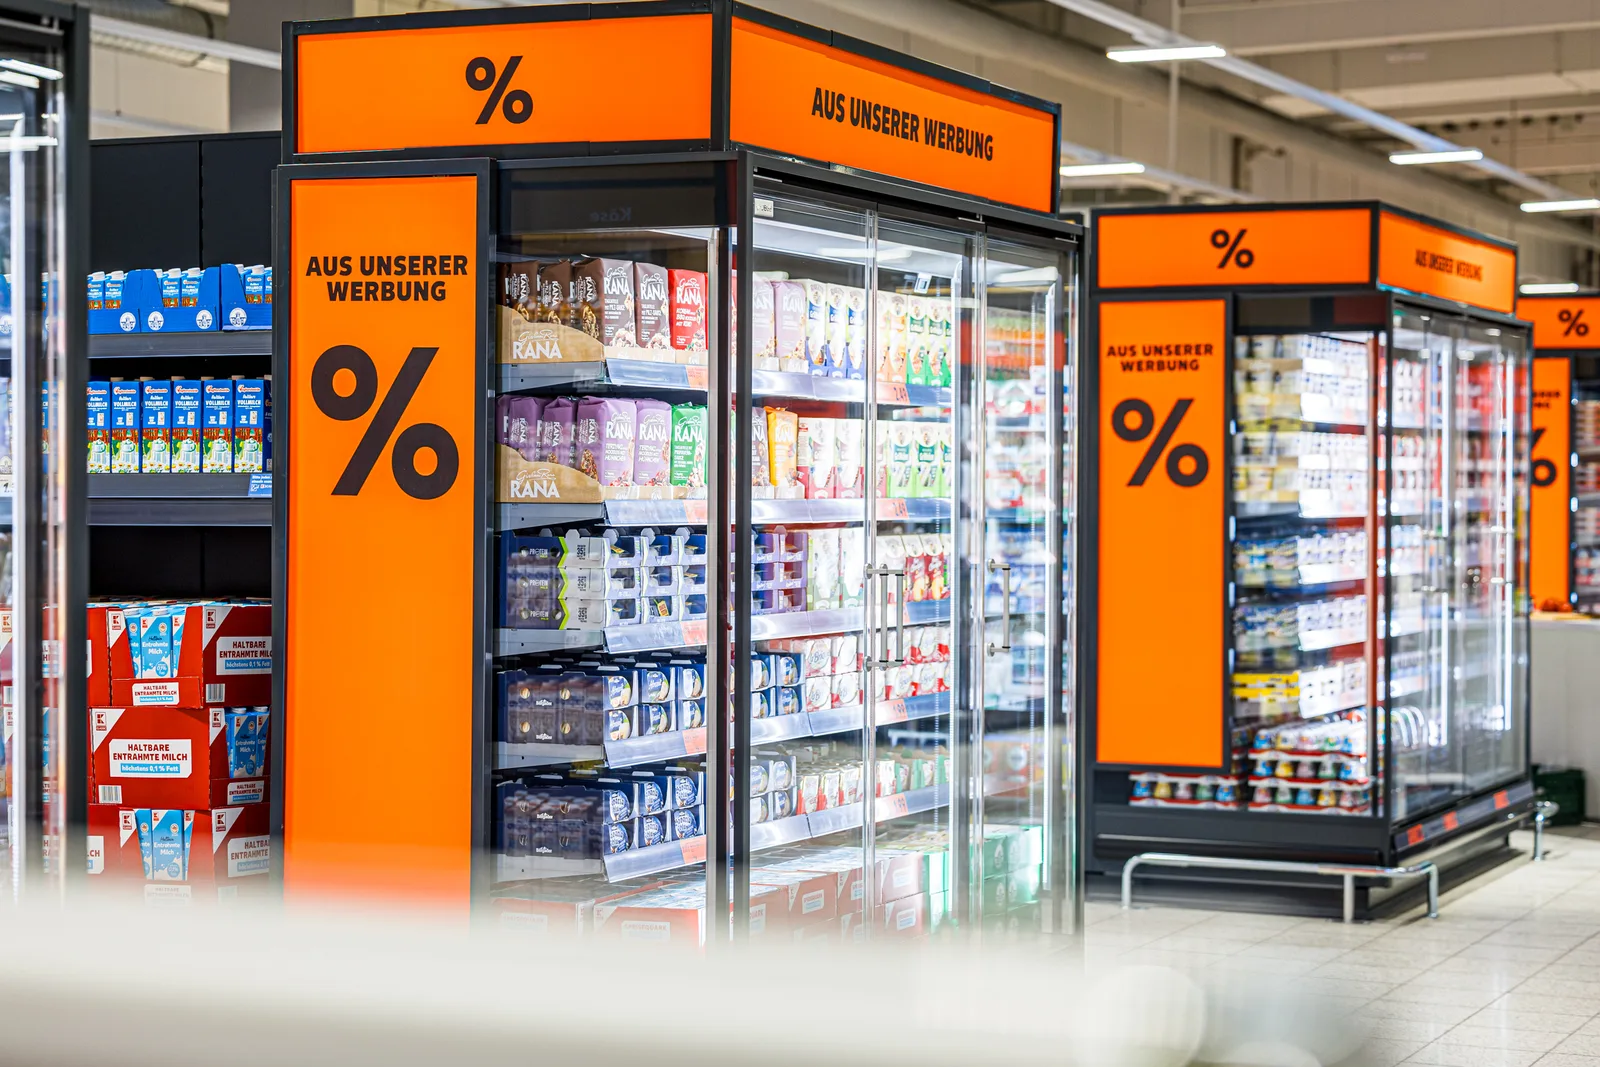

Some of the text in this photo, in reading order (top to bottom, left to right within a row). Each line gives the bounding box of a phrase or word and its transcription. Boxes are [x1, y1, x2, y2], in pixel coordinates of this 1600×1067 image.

[465, 55, 533, 125] %
[811, 87, 995, 162] AUS UNSERER WERBUNG
[1211, 229, 1255, 269] %
[306, 255, 468, 276] AUS UNSERER
[327, 281, 446, 302] WERBUNG
[676, 287, 702, 305] RANA
[513, 341, 563, 360] RANA
[1106, 343, 1214, 358] AUS UNSERER
[1121, 358, 1200, 372] WERBUNG
[311, 345, 460, 500] %
[606, 421, 633, 440] RANA
[639, 423, 667, 442] RANA
[674, 425, 703, 443] RANA
[1111, 398, 1210, 488] %
[510, 480, 560, 498] RANA
[529, 579, 549, 587] PROTEIN
[233, 641, 266, 649] HALTBARE
[219, 650, 272, 659] ENTRAHMTE MILC
[113, 752, 188, 761] ENTRAHMTE MILCH
[127, 743, 170, 752] HALTBARE
[149, 765, 158, 773] 0,1
[244, 840, 270, 849] HALTBA
[230, 849, 268, 860] ENTRAHMTE
